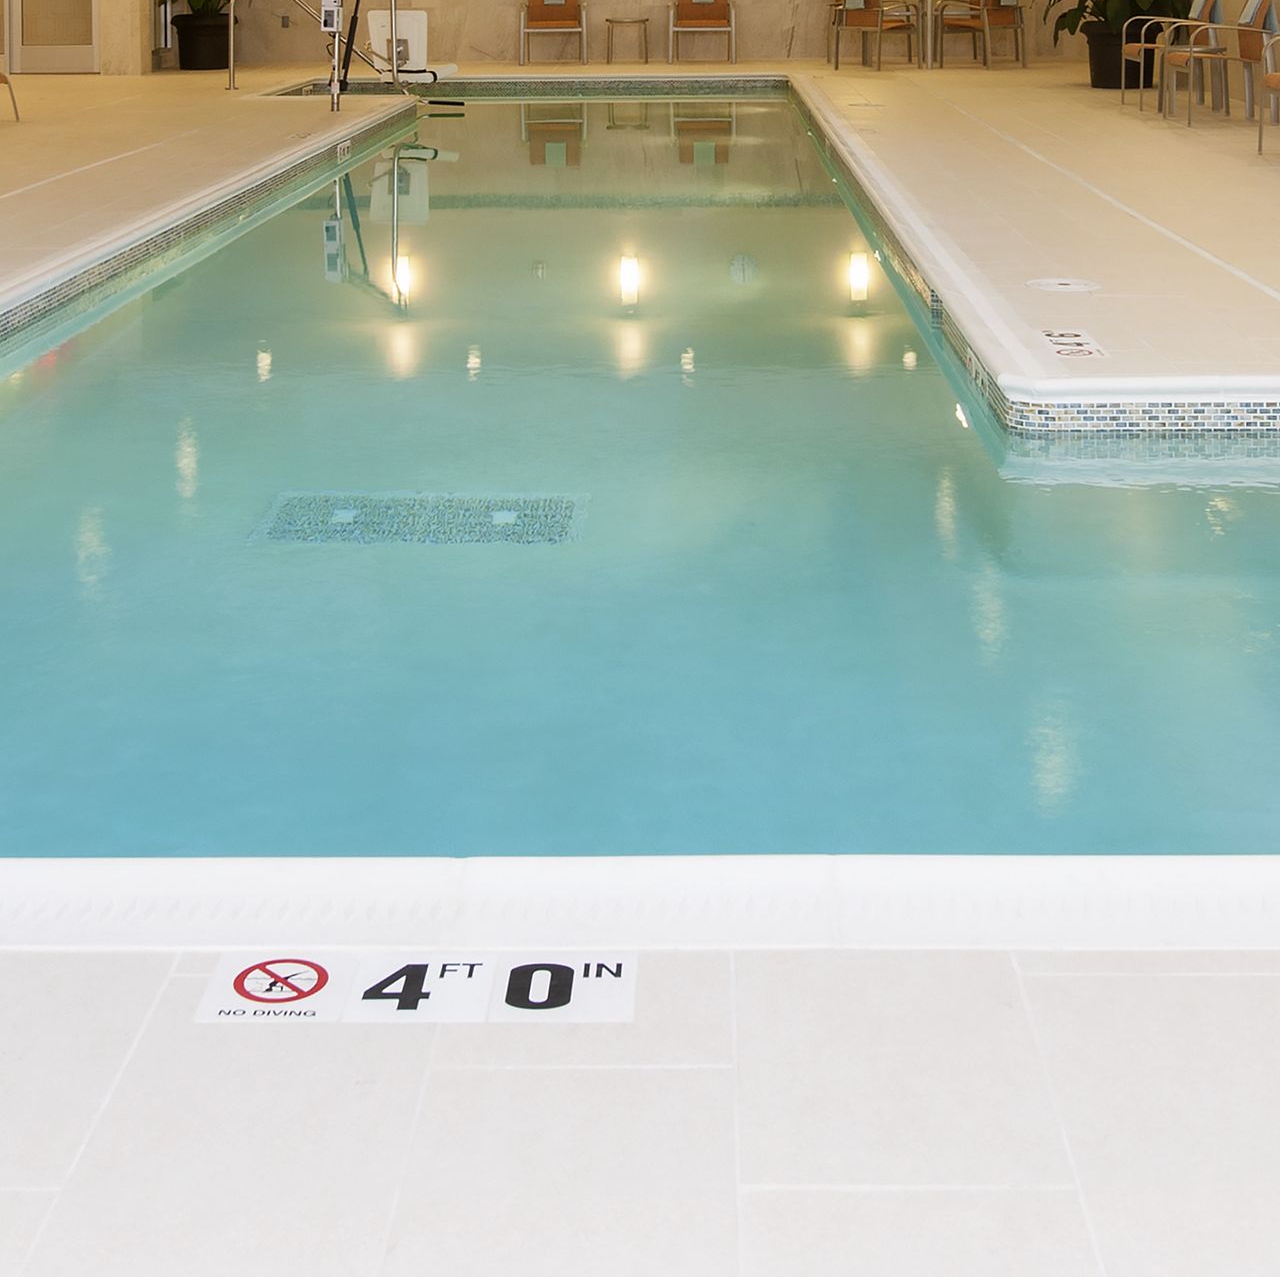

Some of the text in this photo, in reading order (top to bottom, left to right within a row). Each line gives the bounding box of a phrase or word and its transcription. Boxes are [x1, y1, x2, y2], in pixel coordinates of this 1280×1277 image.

[362, 963, 622, 1010] 4 FT 0 IN
[252, 1009, 317, 1017] DIVING
